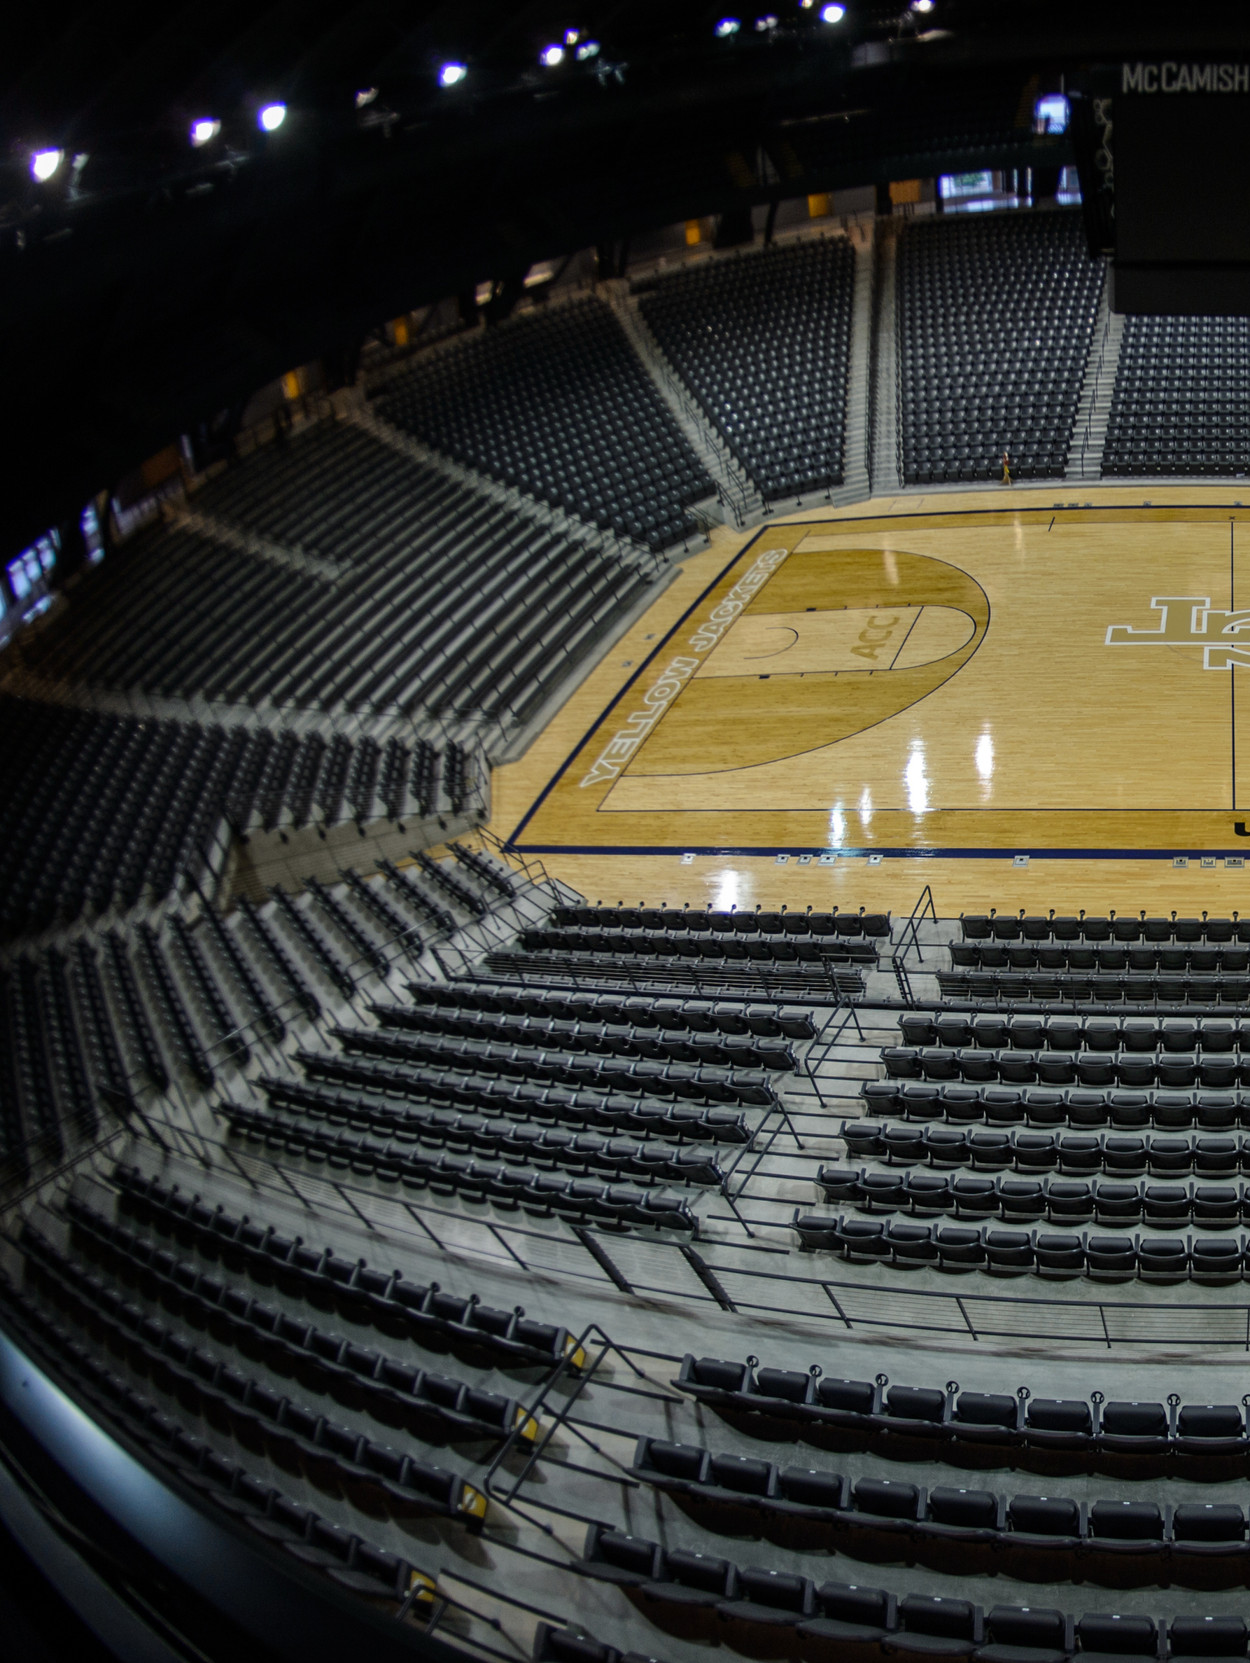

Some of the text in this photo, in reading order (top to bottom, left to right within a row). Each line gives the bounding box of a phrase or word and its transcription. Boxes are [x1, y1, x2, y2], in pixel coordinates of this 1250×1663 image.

[580, 548, 788, 788] YELLOW JACKETS
[849, 614, 901, 661] ACC
